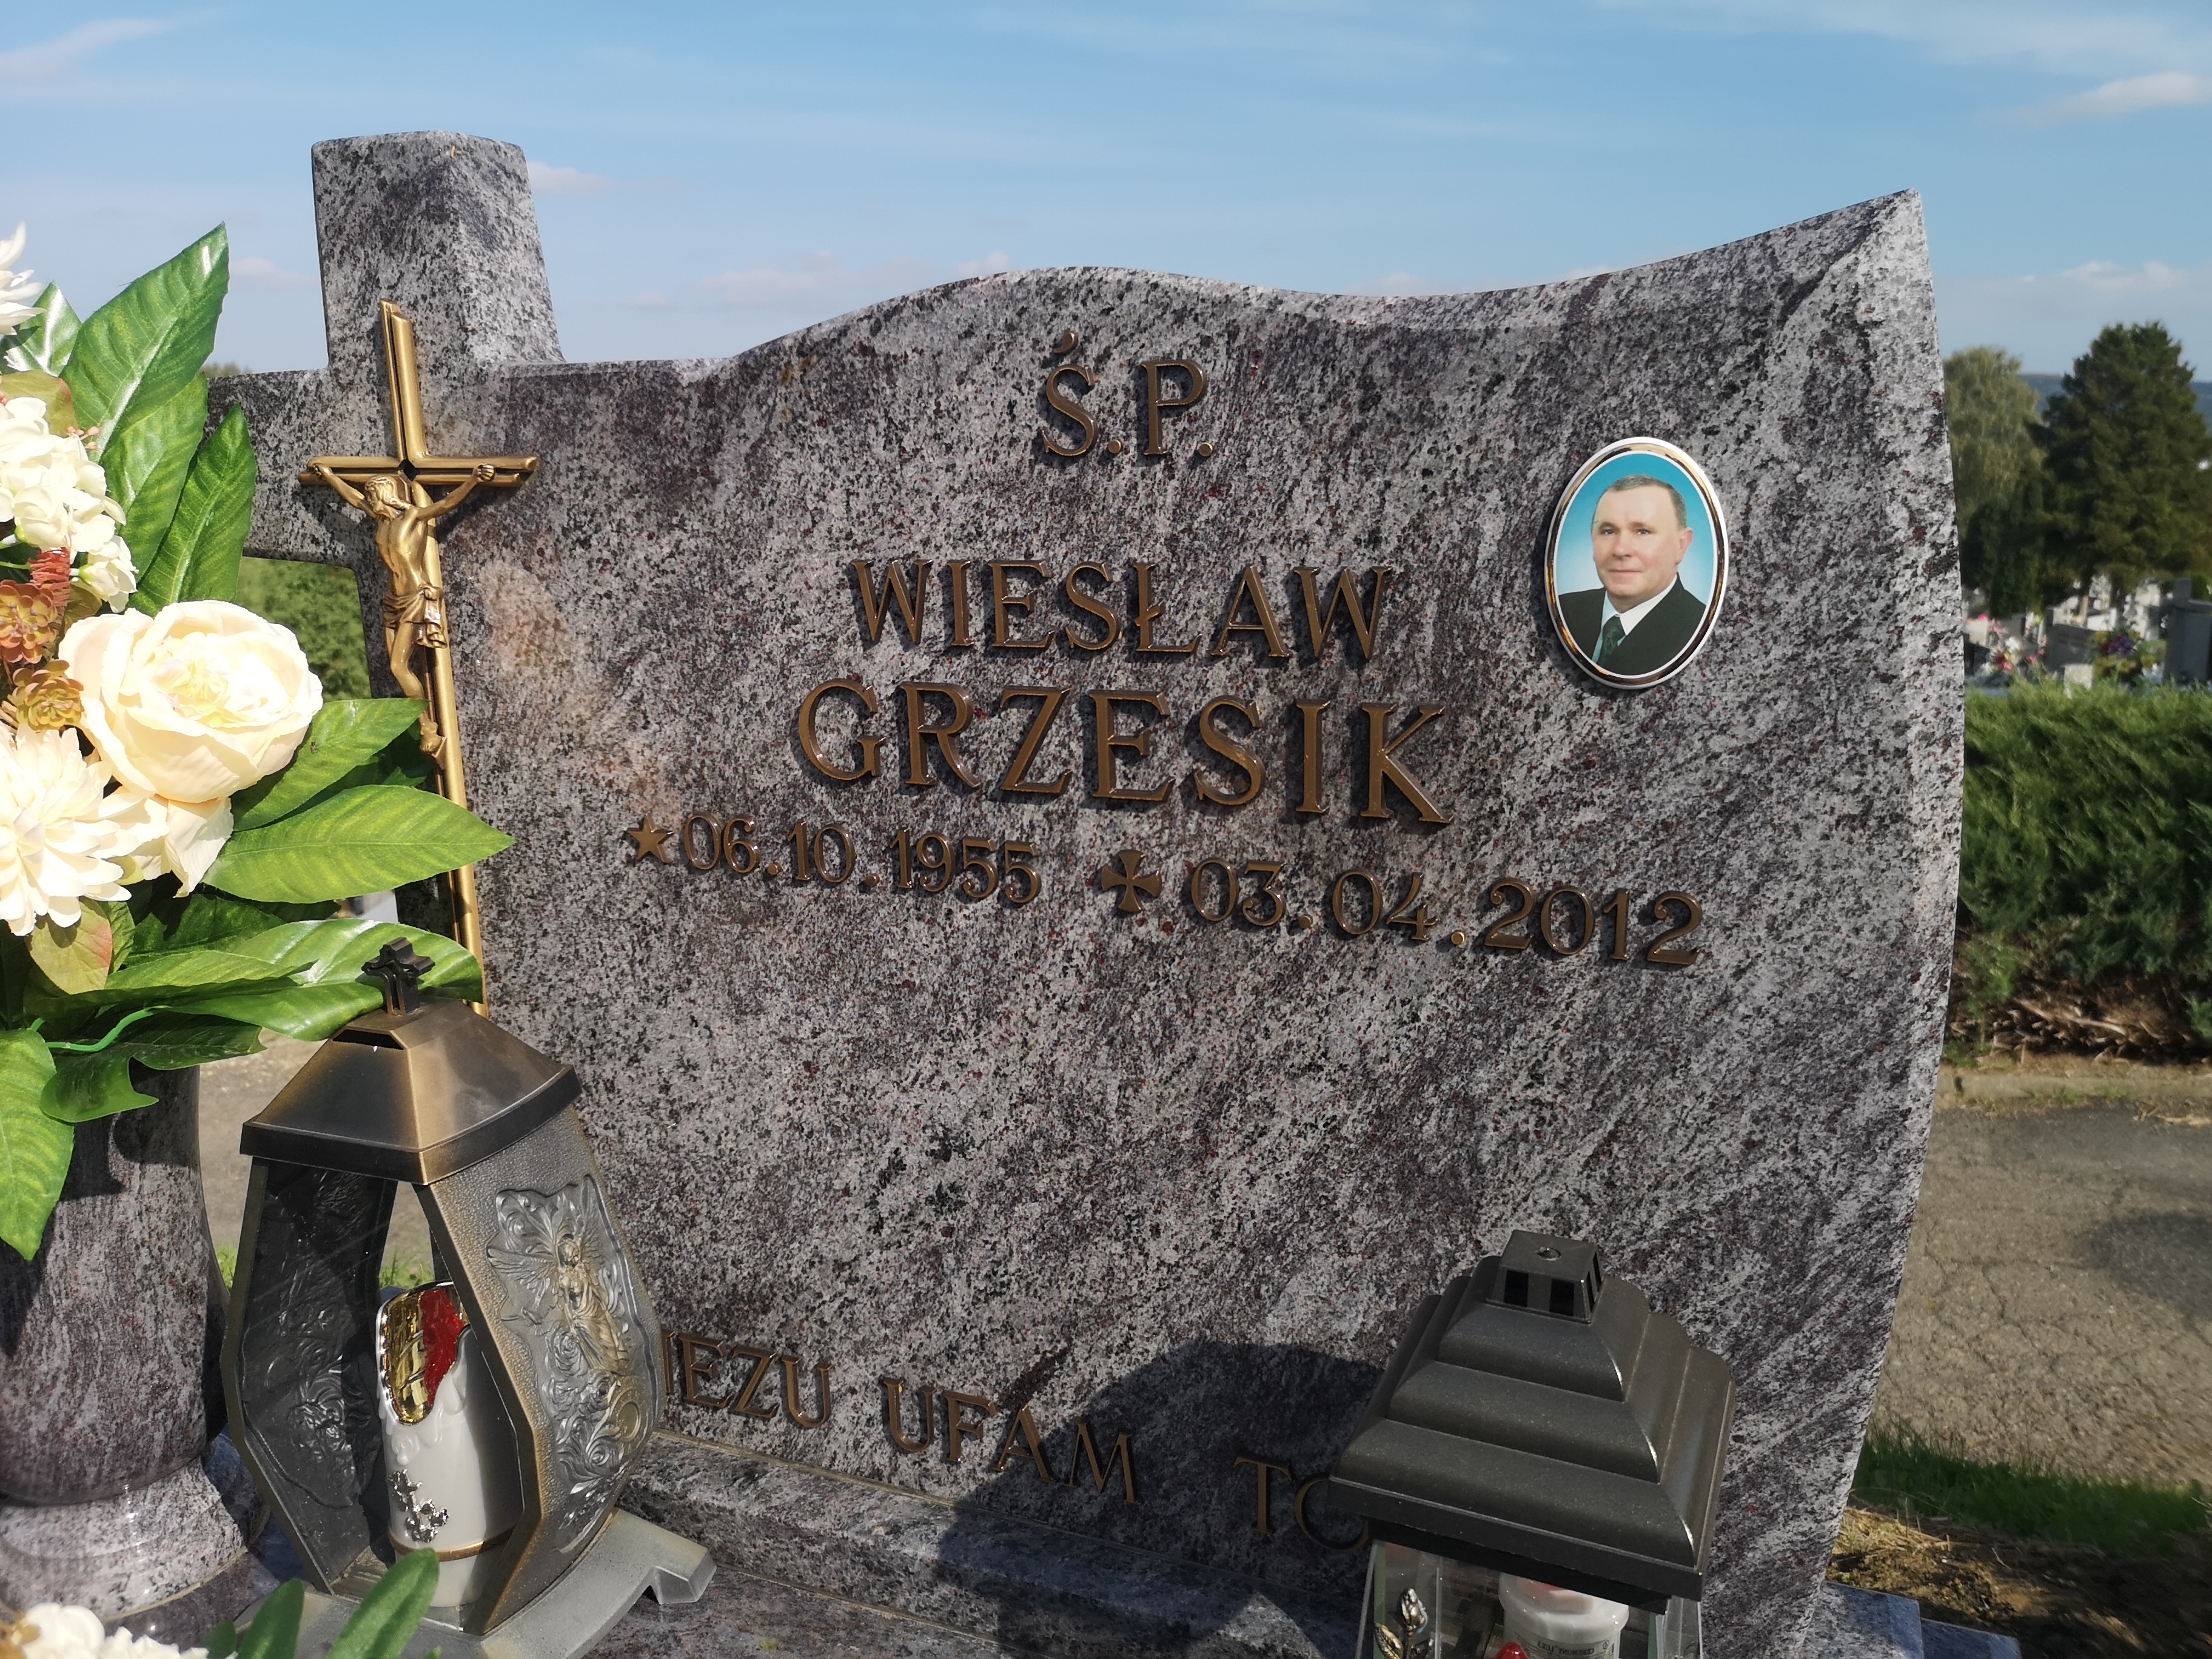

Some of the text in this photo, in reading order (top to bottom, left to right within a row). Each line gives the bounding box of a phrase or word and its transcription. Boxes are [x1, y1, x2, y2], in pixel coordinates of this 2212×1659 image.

[850, 558, 1392, 660] WIESŁAW
[797, 678, 1453, 824] GRZESIK
[882, 1376, 1138, 1505] UFAM
